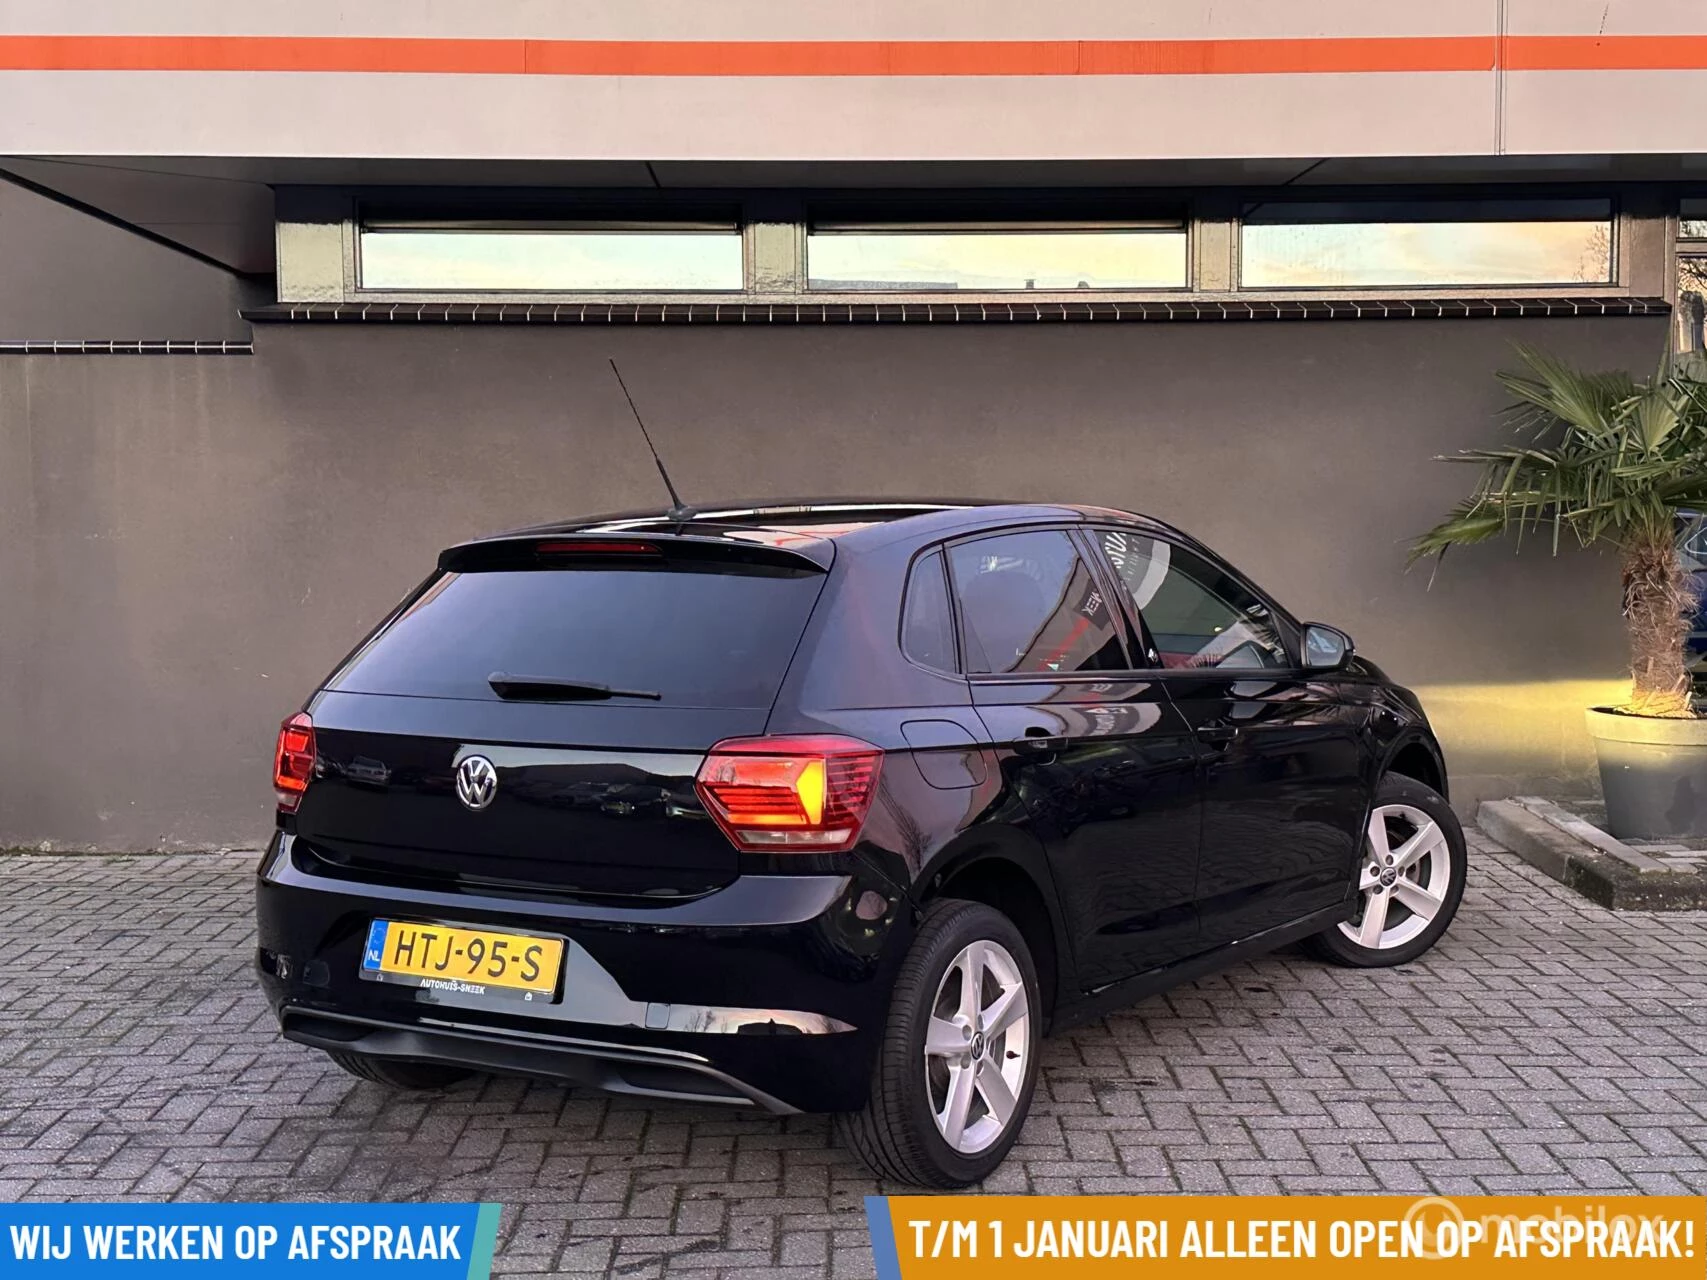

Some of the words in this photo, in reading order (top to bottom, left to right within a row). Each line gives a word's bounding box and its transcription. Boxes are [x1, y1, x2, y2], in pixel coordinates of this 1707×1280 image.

[368, 950, 380, 962] NL
[393, 929, 544, 982] HTJ-95-S
[420, 978, 486, 995] AUTOHUIS-SNEEK
